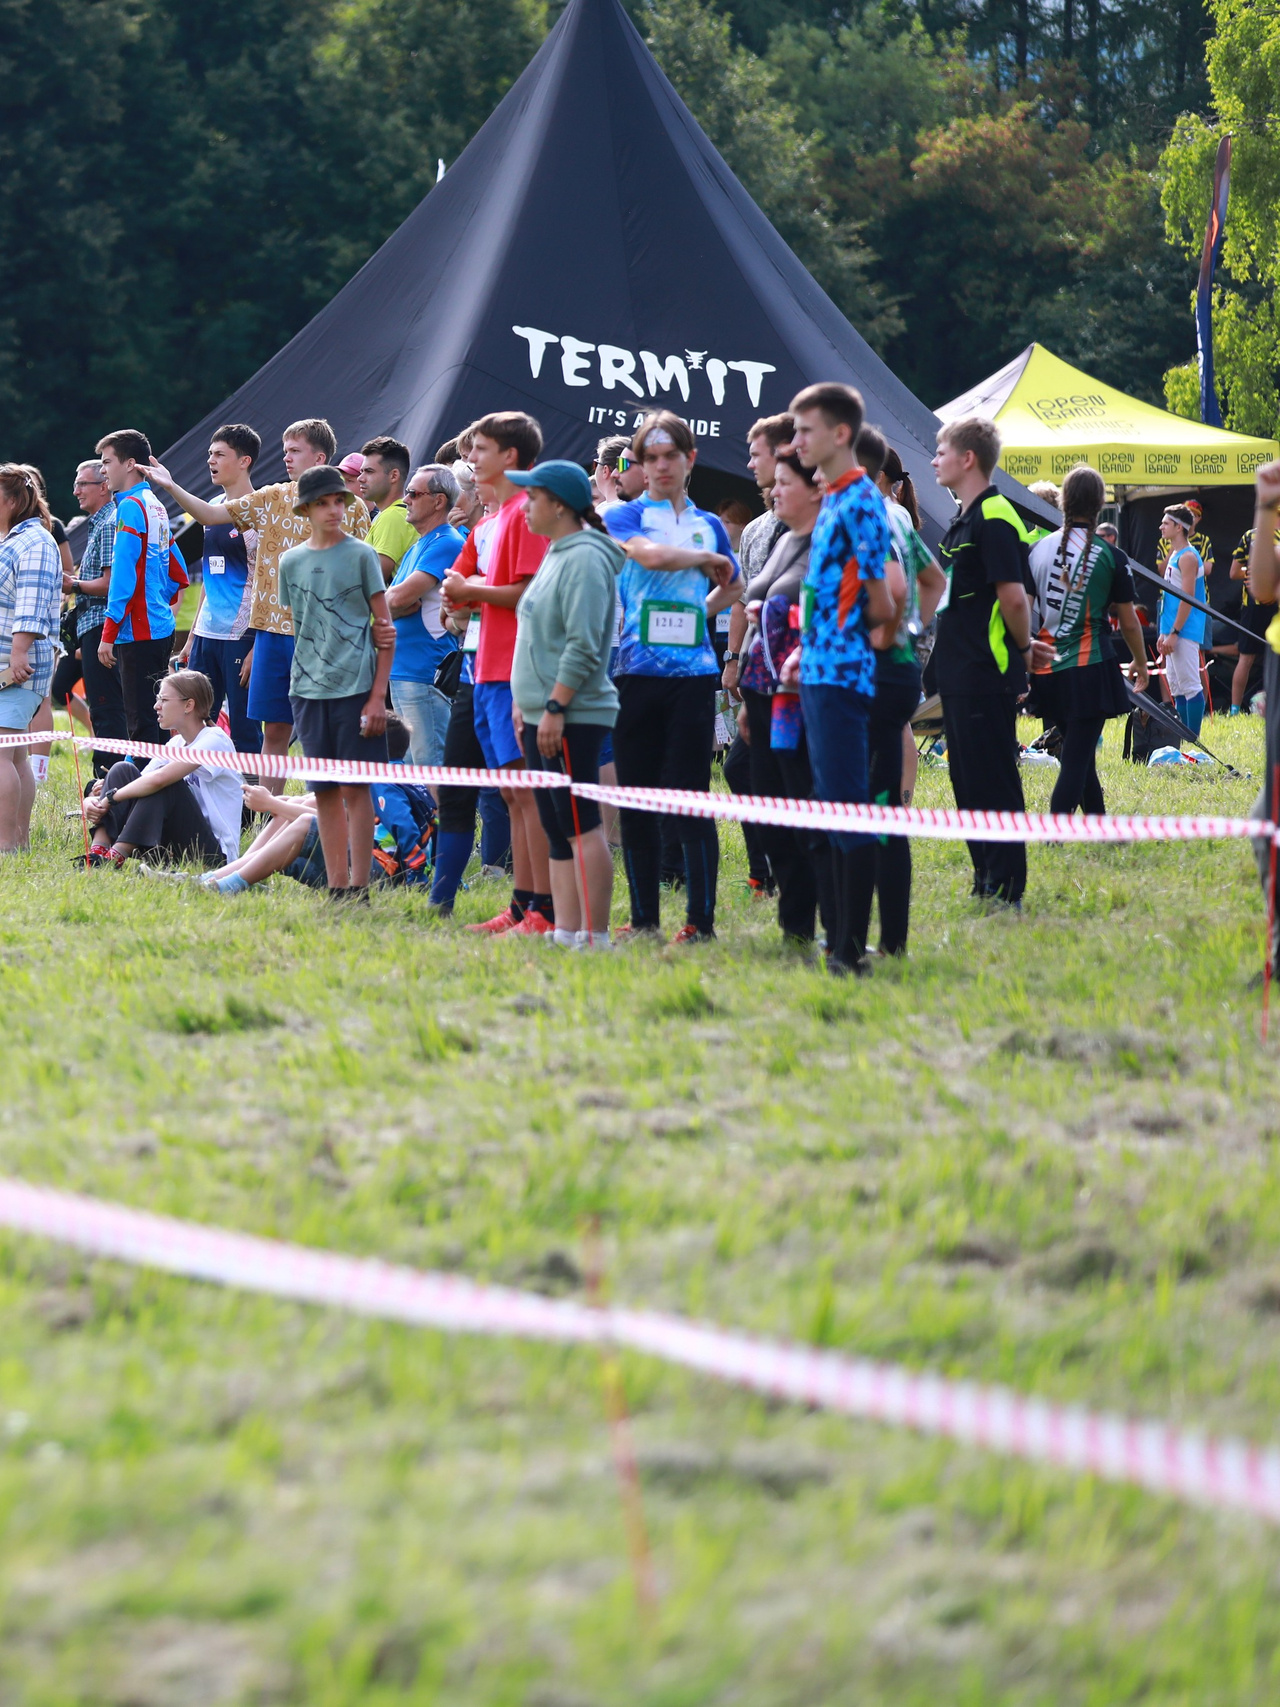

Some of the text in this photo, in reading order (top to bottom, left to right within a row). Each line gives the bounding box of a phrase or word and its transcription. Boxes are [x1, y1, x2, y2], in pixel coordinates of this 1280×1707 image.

[511, 325, 777, 408] TERMIT
[588, 406, 627, 428] IT'S
[655, 616, 683, 627] 121.2
